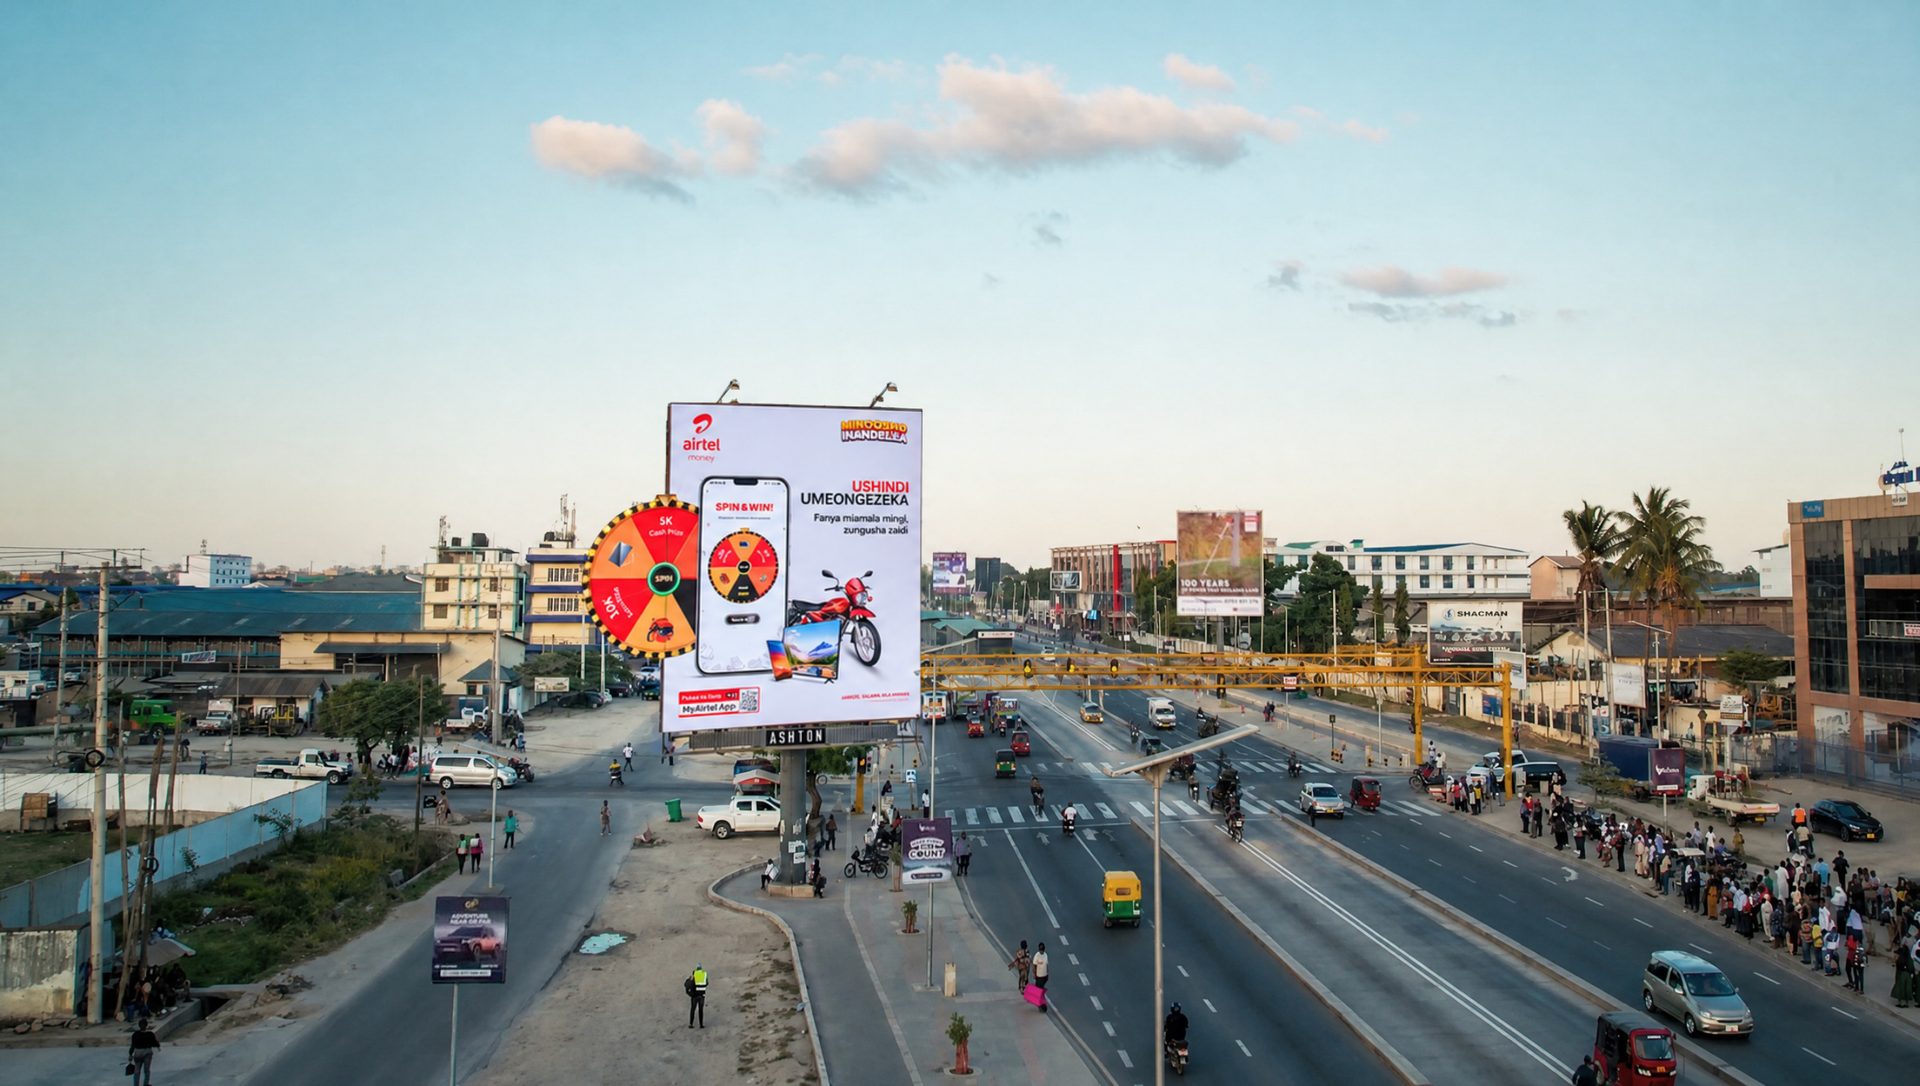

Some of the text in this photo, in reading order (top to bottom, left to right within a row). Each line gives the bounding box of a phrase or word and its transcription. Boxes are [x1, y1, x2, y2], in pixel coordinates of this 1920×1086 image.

[683, 437, 720, 451] airtel
[852, 480, 909, 493] USHINDI
[801, 492, 909, 506] UMEONGEZEKA
[716, 503, 774, 512] SPIN & WIN!
[814, 513, 841, 524] Fanya
[843, 514, 880, 523] miamala
[843, 526, 909, 536] zungusha zaidi
[1181, 579, 1230, 587] 100 YEARS
[682, 703, 737, 714] MyAirtel App
[769, 729, 823, 745] ASHTON
[910, 849, 944, 858] COUNT
